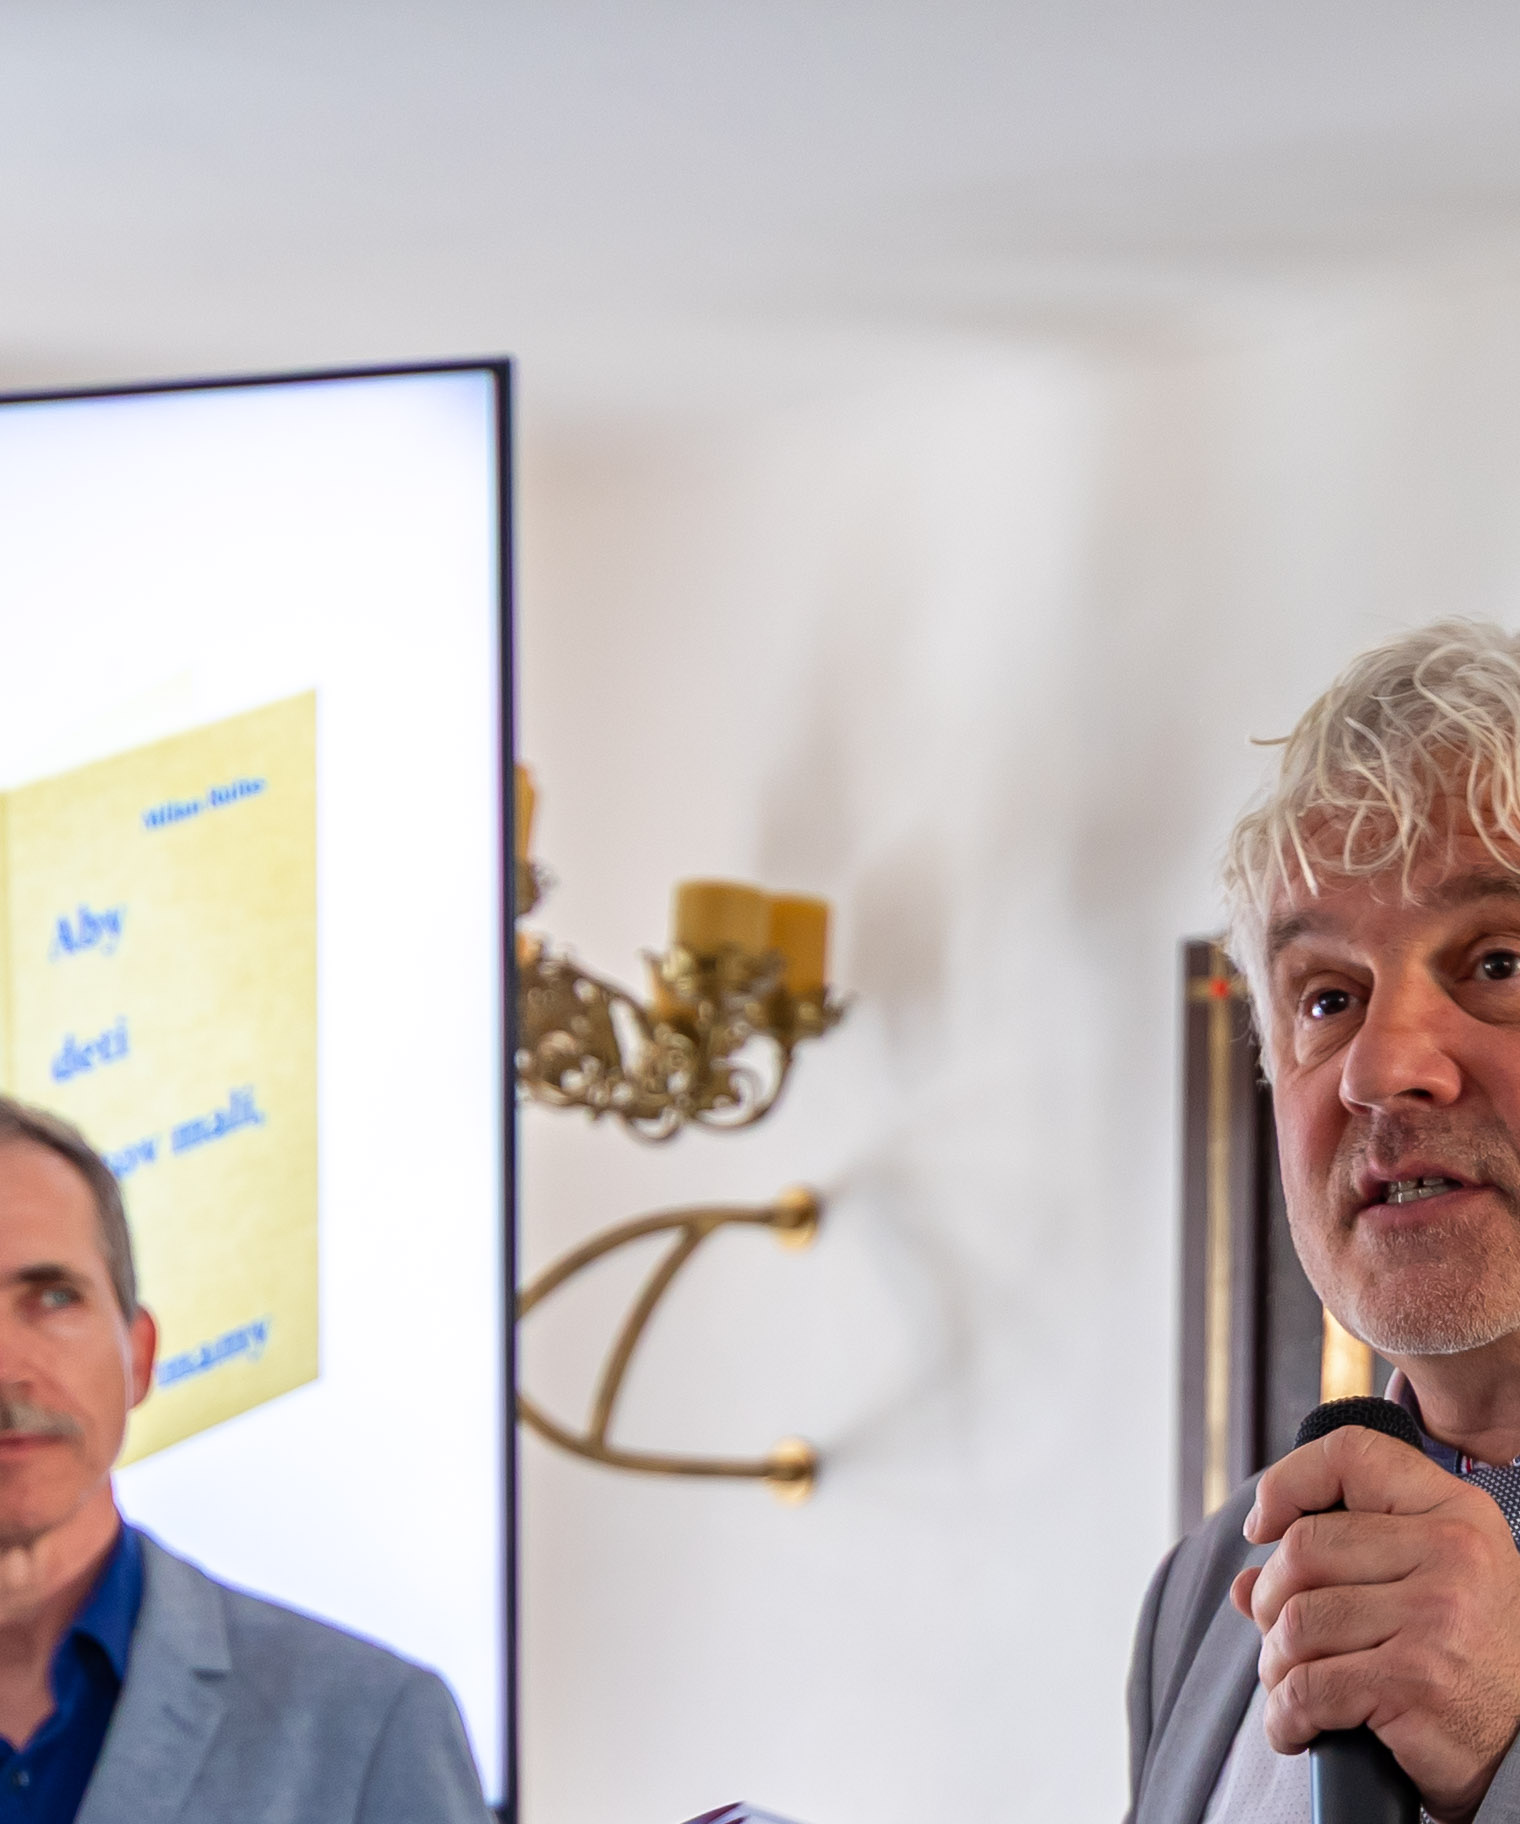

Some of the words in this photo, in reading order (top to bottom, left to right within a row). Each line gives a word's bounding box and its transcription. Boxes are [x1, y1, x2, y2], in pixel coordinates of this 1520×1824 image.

[50, 903, 128, 963] Aby
[50, 1014, 129, 1083] deti
[170, 1085, 266, 1155] mali,
[156, 1315, 264, 1389] mamy
